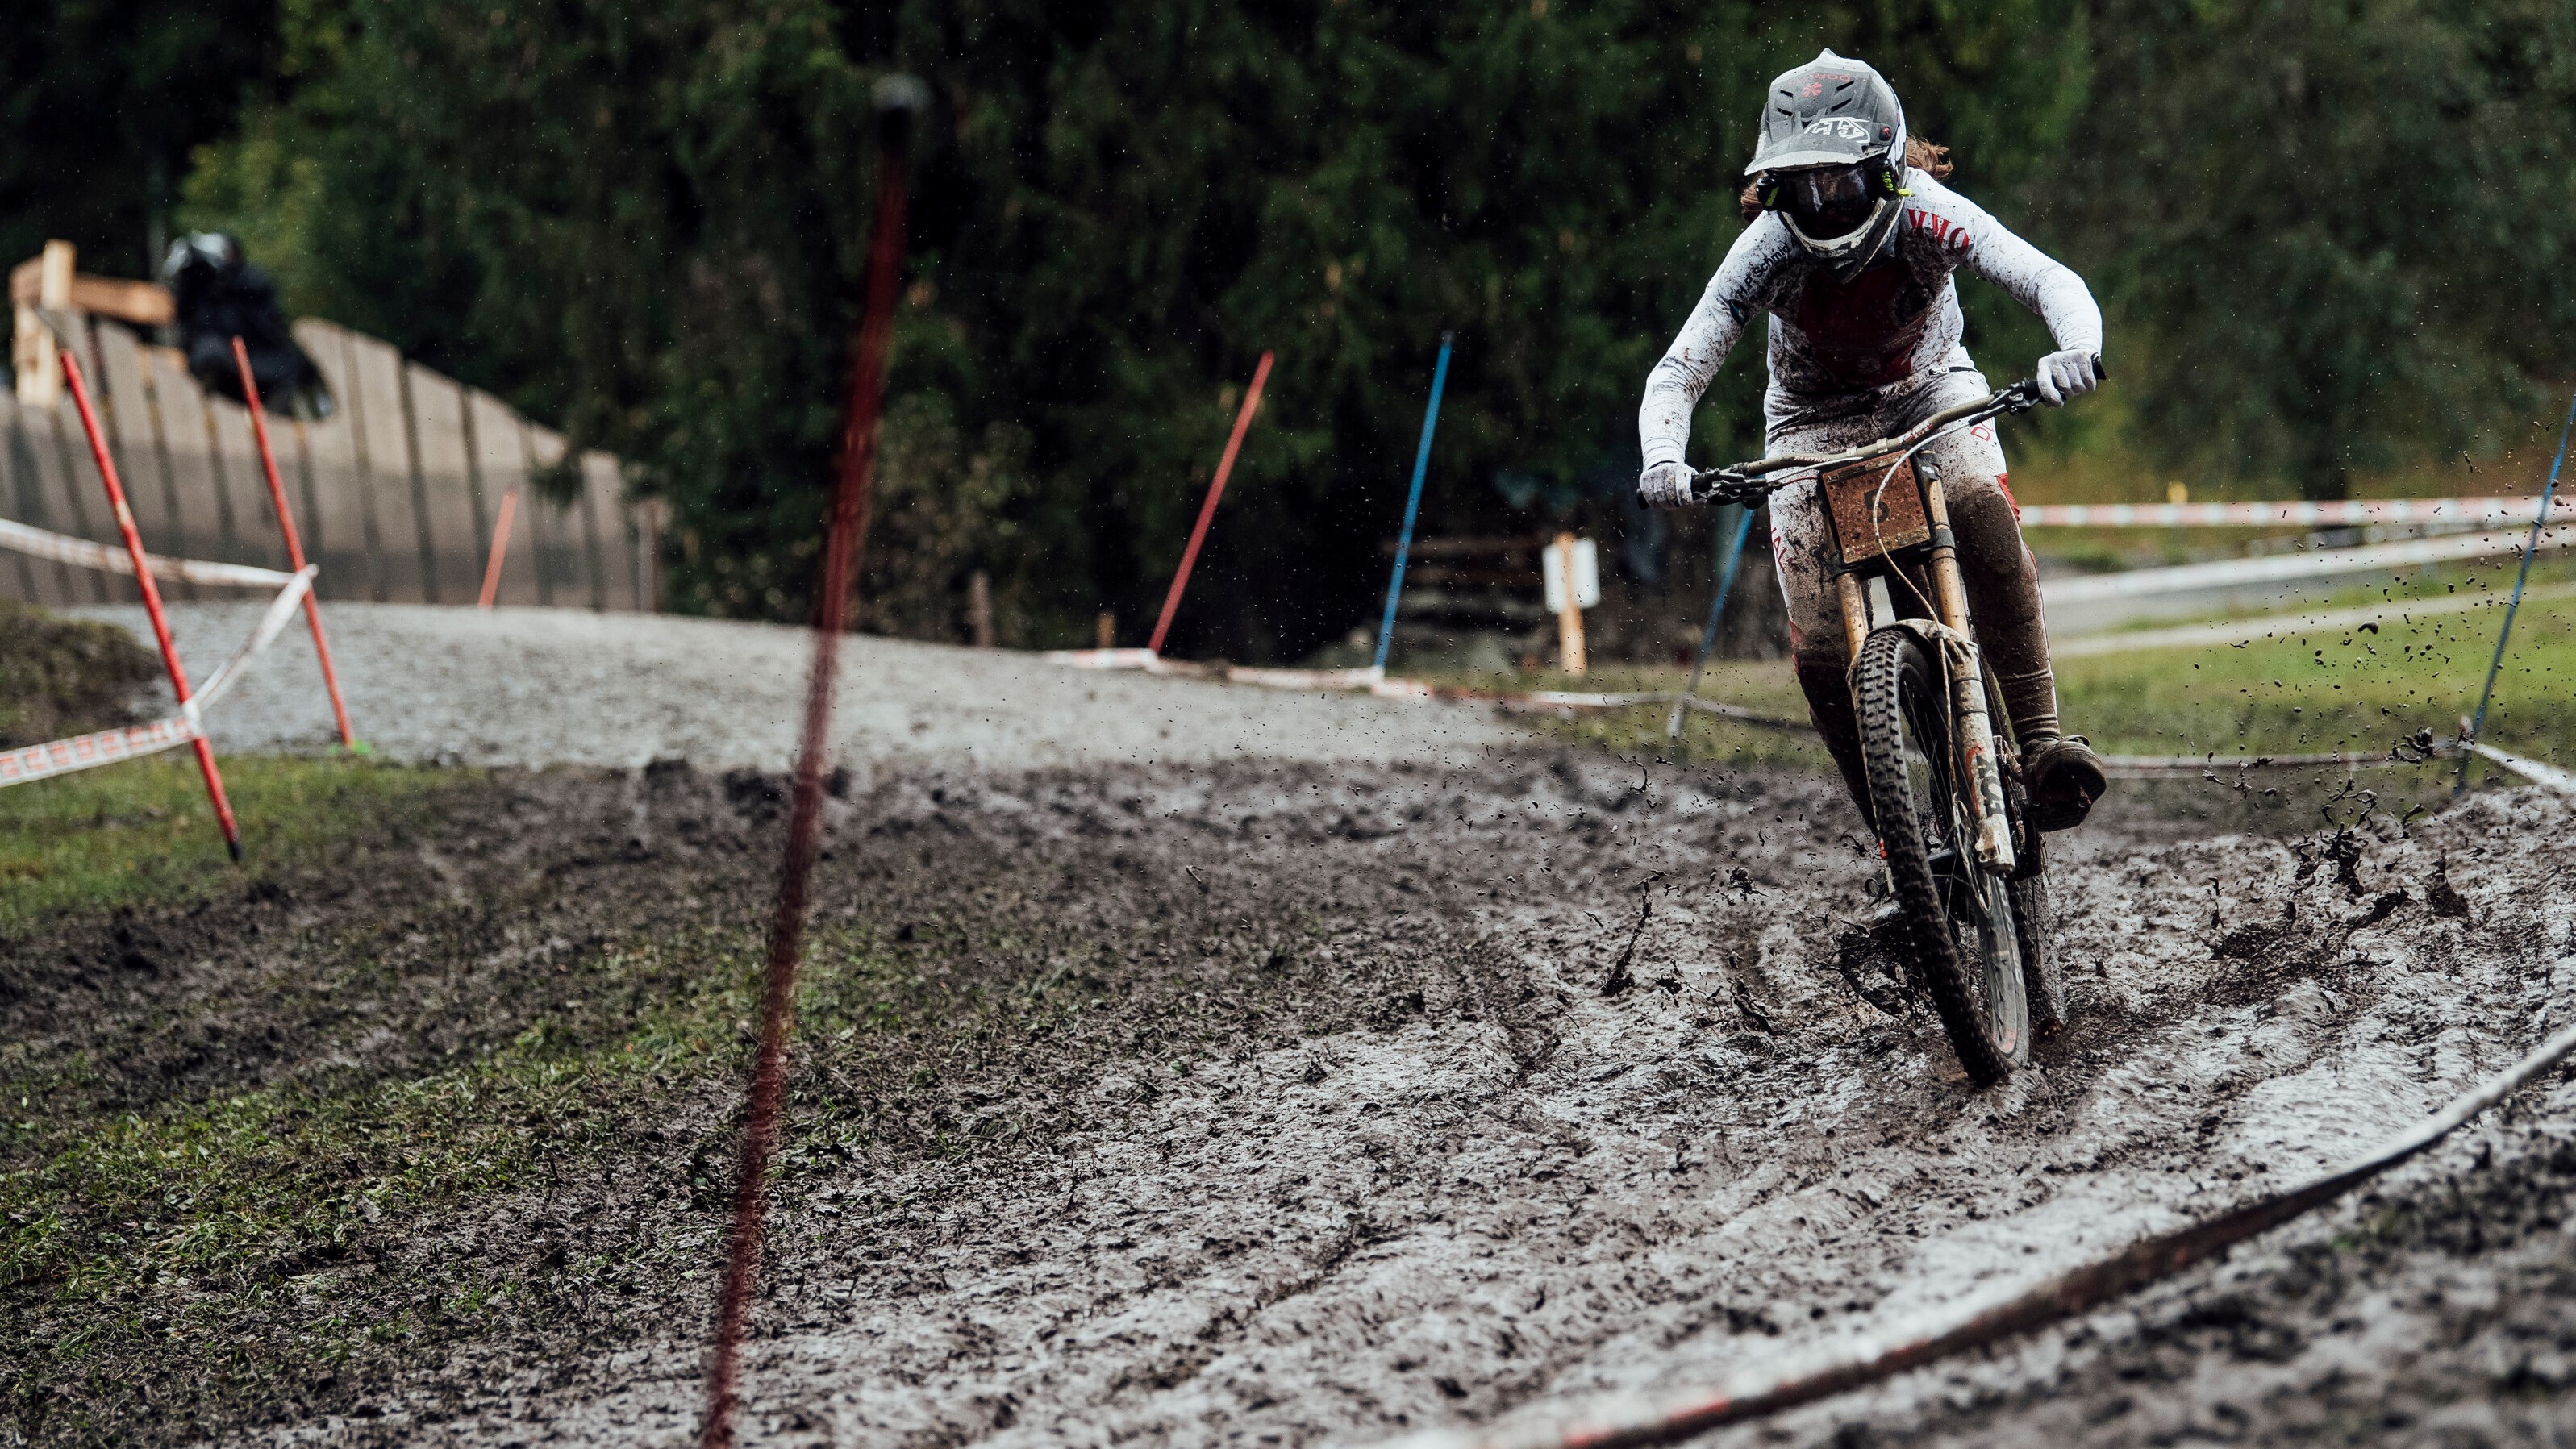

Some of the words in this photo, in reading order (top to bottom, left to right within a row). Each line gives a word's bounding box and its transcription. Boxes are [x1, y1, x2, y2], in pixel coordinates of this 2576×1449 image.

[1753, 242, 1791, 277] Schmid
[1864, 488, 1890, 524] 5
[1976, 753, 2006, 819] FOX
